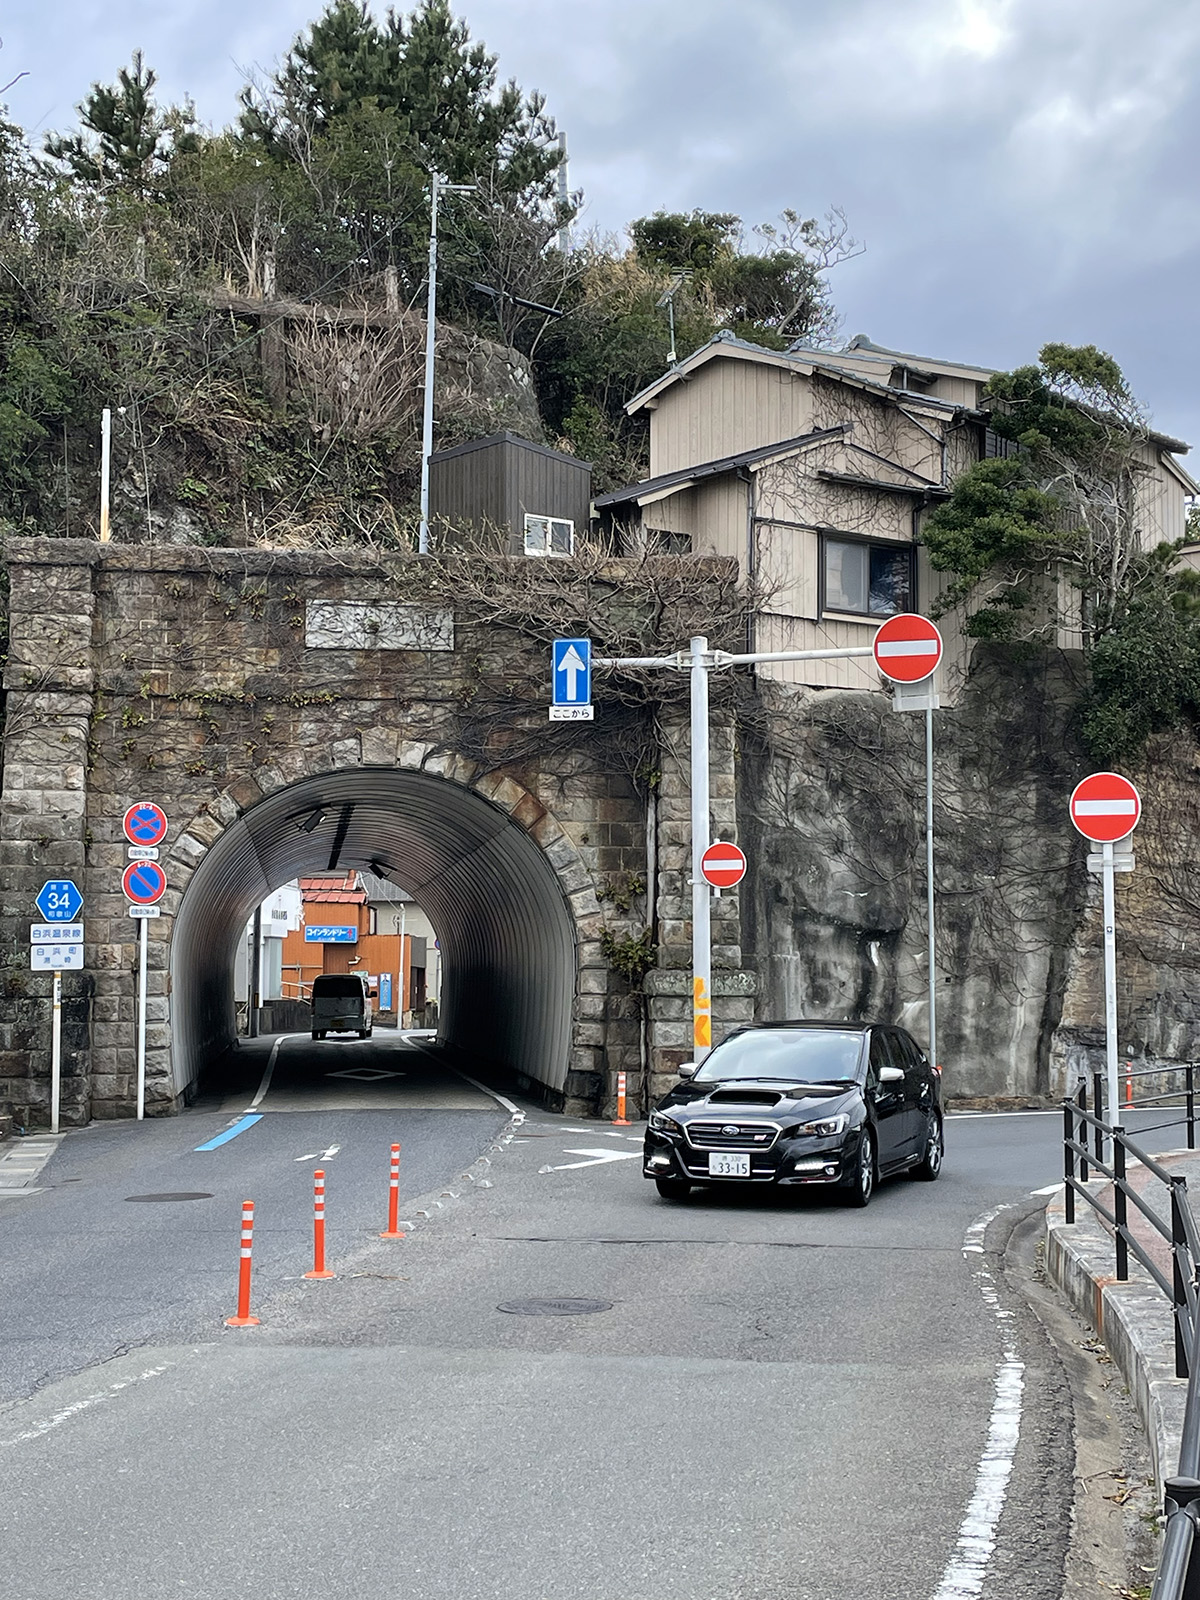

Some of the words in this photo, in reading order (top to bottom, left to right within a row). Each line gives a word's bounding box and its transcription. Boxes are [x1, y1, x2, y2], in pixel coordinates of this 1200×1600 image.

[553, 710, 590, 718] ここから
[47, 892, 71, 909] 34
[33, 928, 81, 939] 白浜温泉線
[307, 928, 347, 937] コインランドリー
[718, 1162, 748, 1174] 33-15
